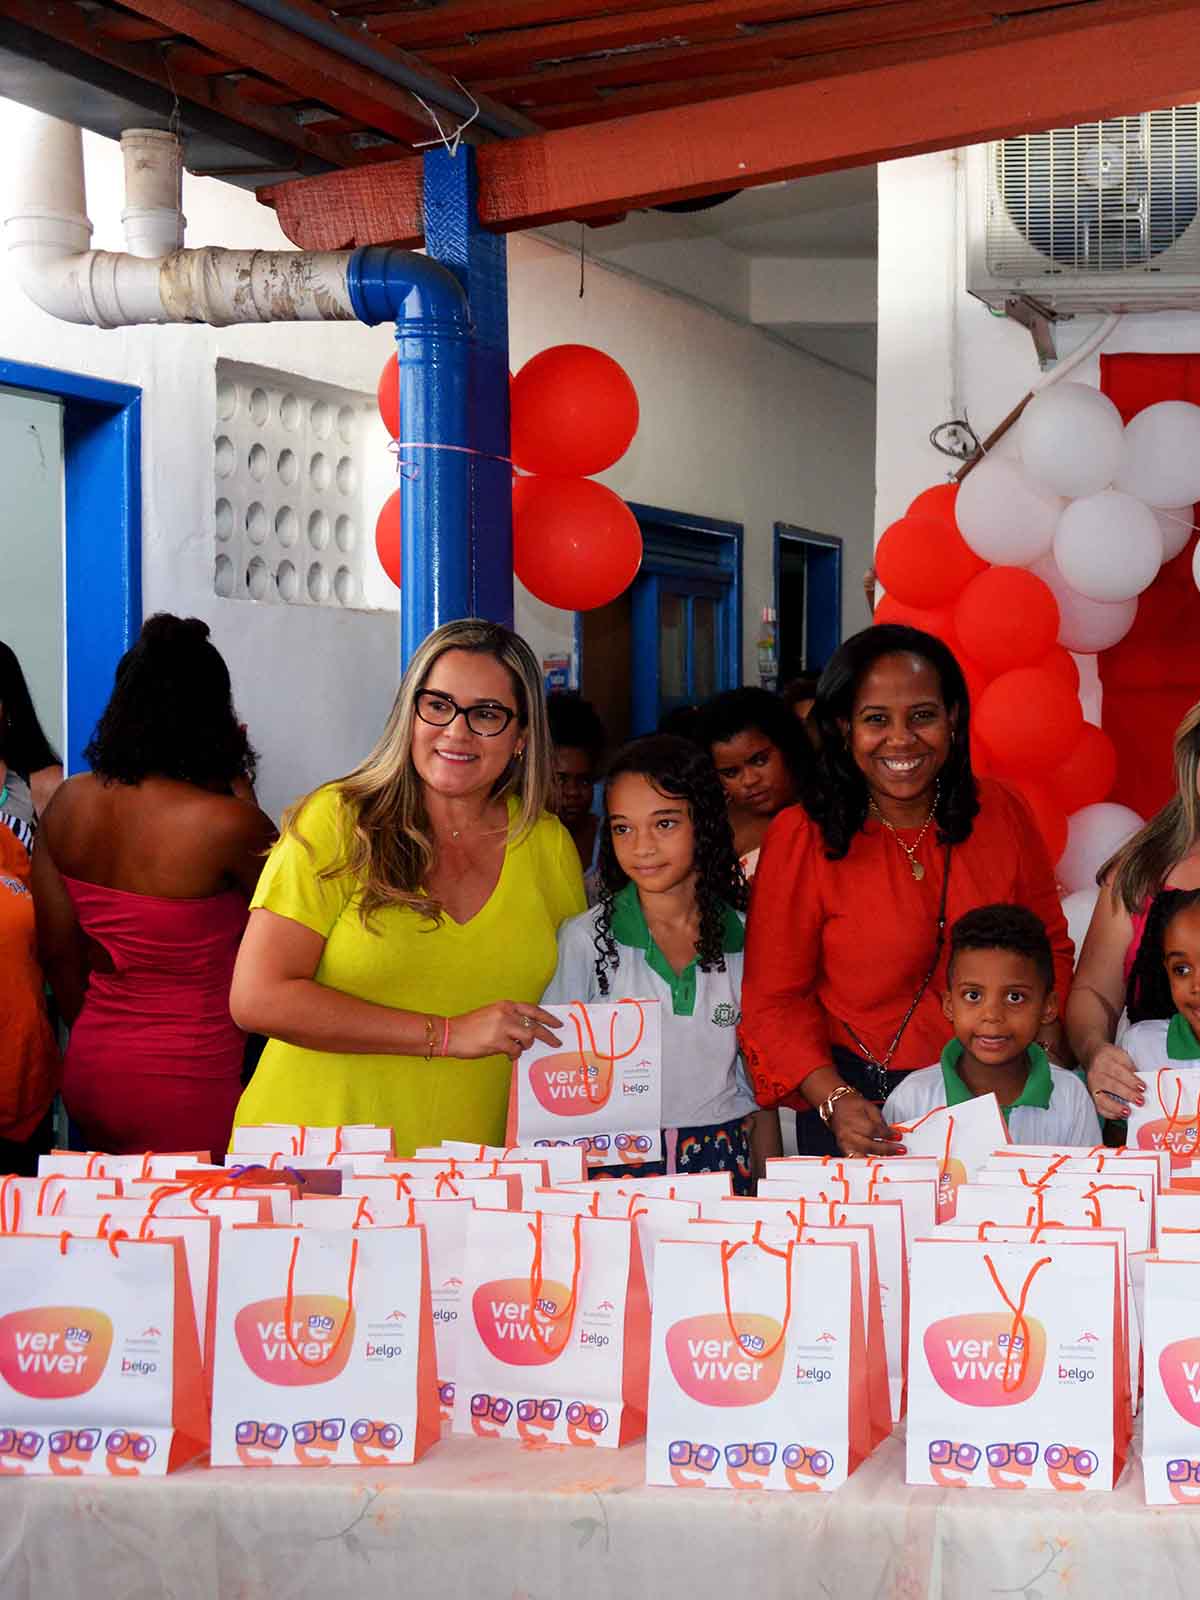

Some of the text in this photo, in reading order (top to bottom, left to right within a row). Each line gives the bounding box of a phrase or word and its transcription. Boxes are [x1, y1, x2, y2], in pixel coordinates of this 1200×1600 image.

[544, 1071, 577, 1085] ver
[623, 1082, 649, 1094] belgo
[432, 1310, 458, 1322] elgo
[490, 1301, 530, 1320] ver
[256, 1321, 303, 1341] ver
[580, 1330, 609, 1347] belgo
[15, 1332, 61, 1352] ver
[262, 1341, 333, 1361] viver
[366, 1342, 402, 1359] belgo
[687, 1338, 733, 1359] ver
[945, 1339, 992, 1359] ver
[17, 1353, 88, 1375] viver
[121, 1358, 157, 1375] belgo
[692, 1361, 764, 1381] viver
[796, 1365, 831, 1382] belgo
[1058, 1365, 1095, 1382] belgo
